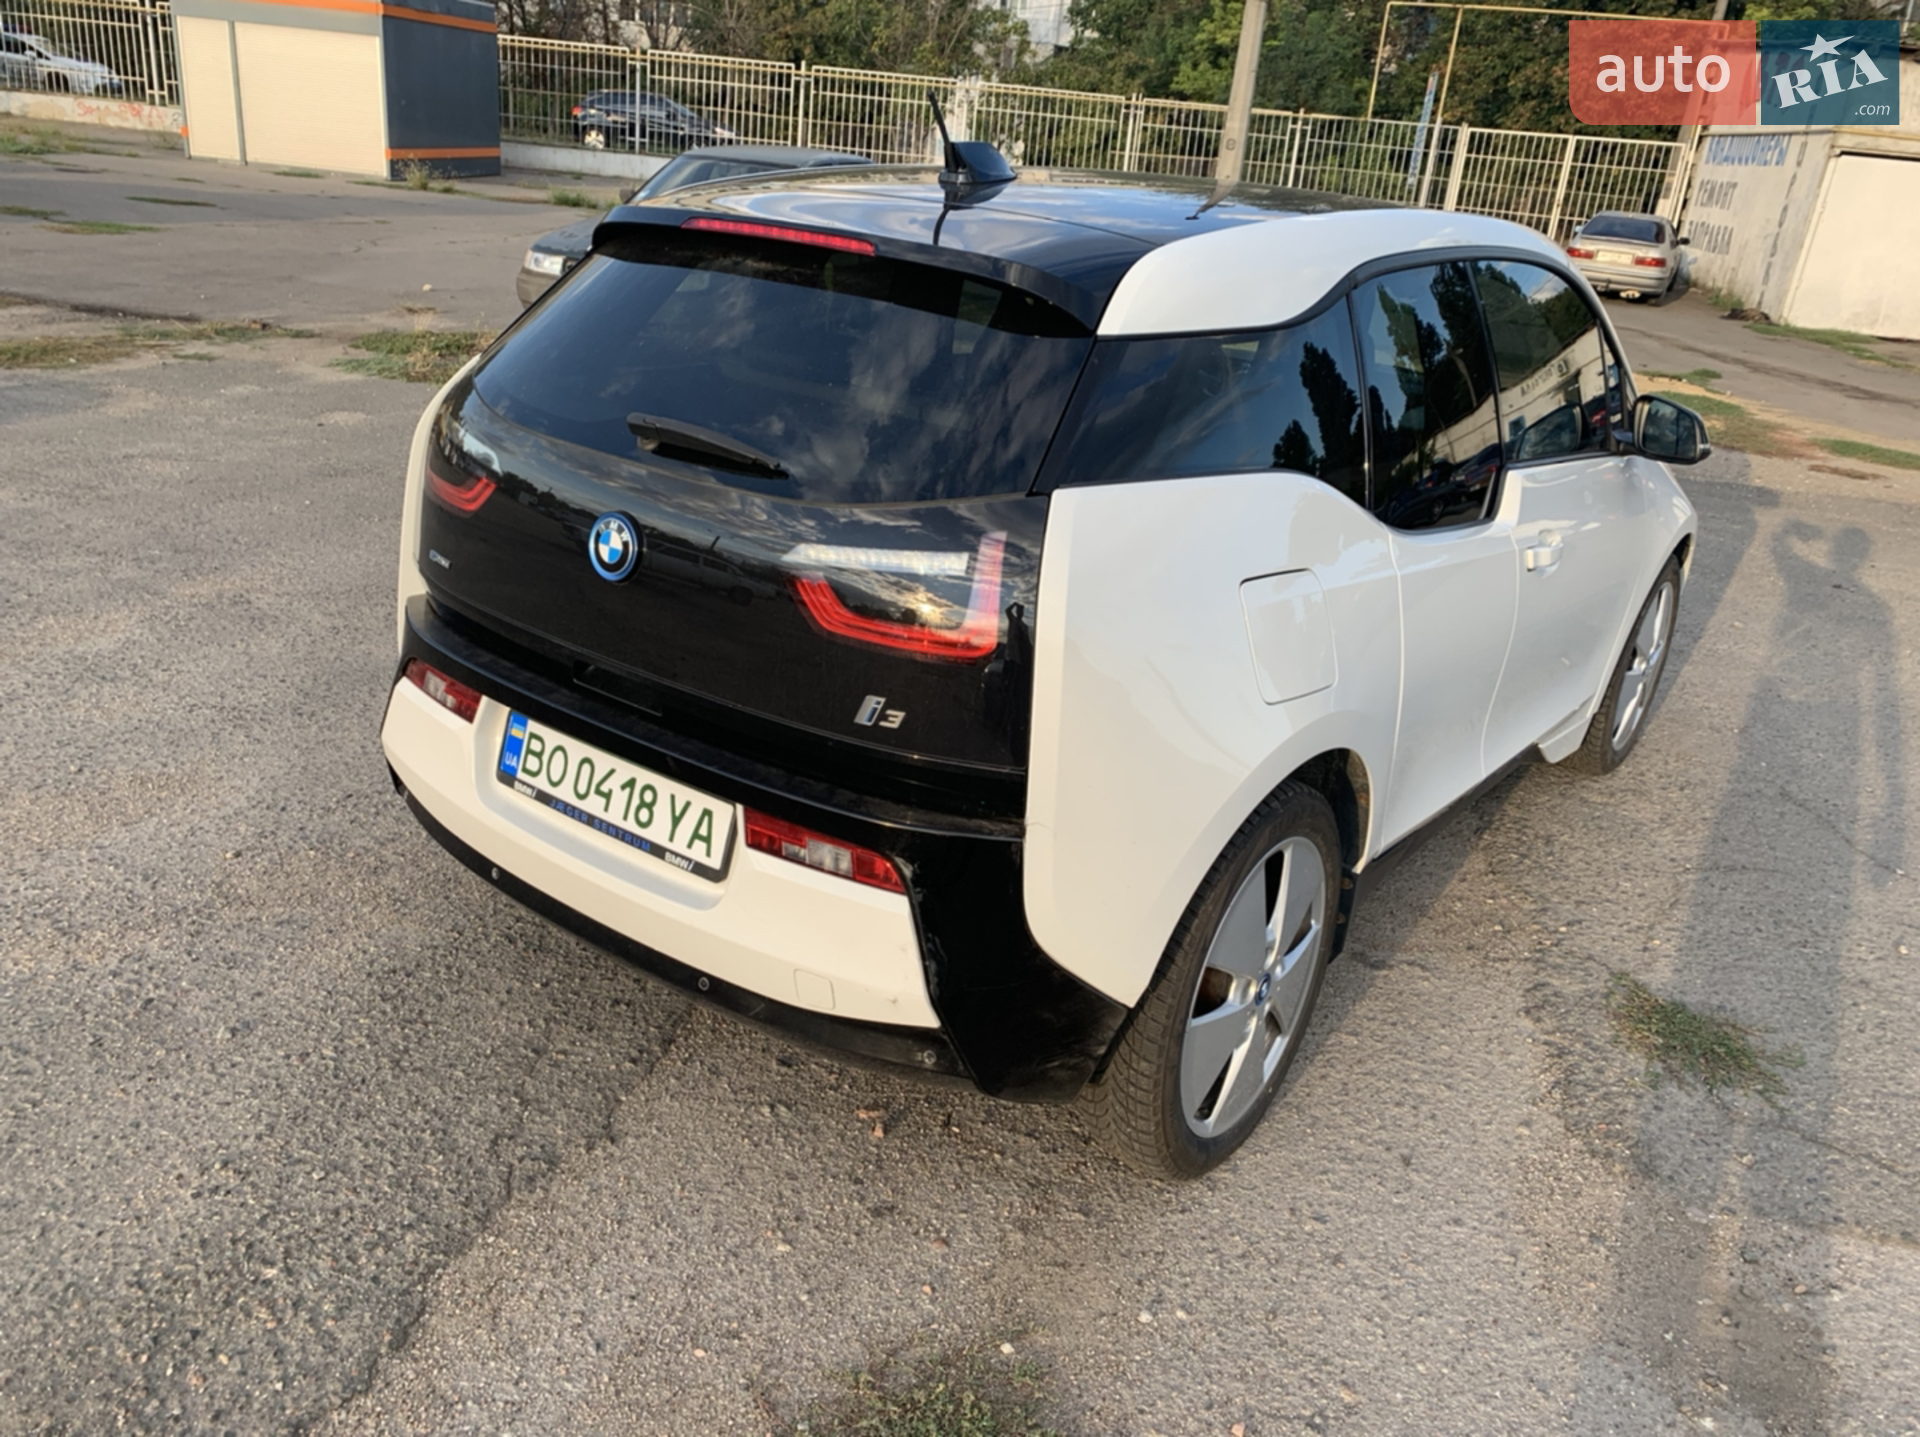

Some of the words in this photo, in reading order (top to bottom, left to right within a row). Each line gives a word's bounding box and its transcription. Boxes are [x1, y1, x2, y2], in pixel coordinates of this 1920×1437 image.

[854, 694, 906, 729] i3
[504, 751, 518, 769] UA
[521, 731, 568, 788] BO
[573, 757, 658, 829] 0418
[668, 793, 714, 858] YA
[592, 818, 651, 851] SENTRUM
